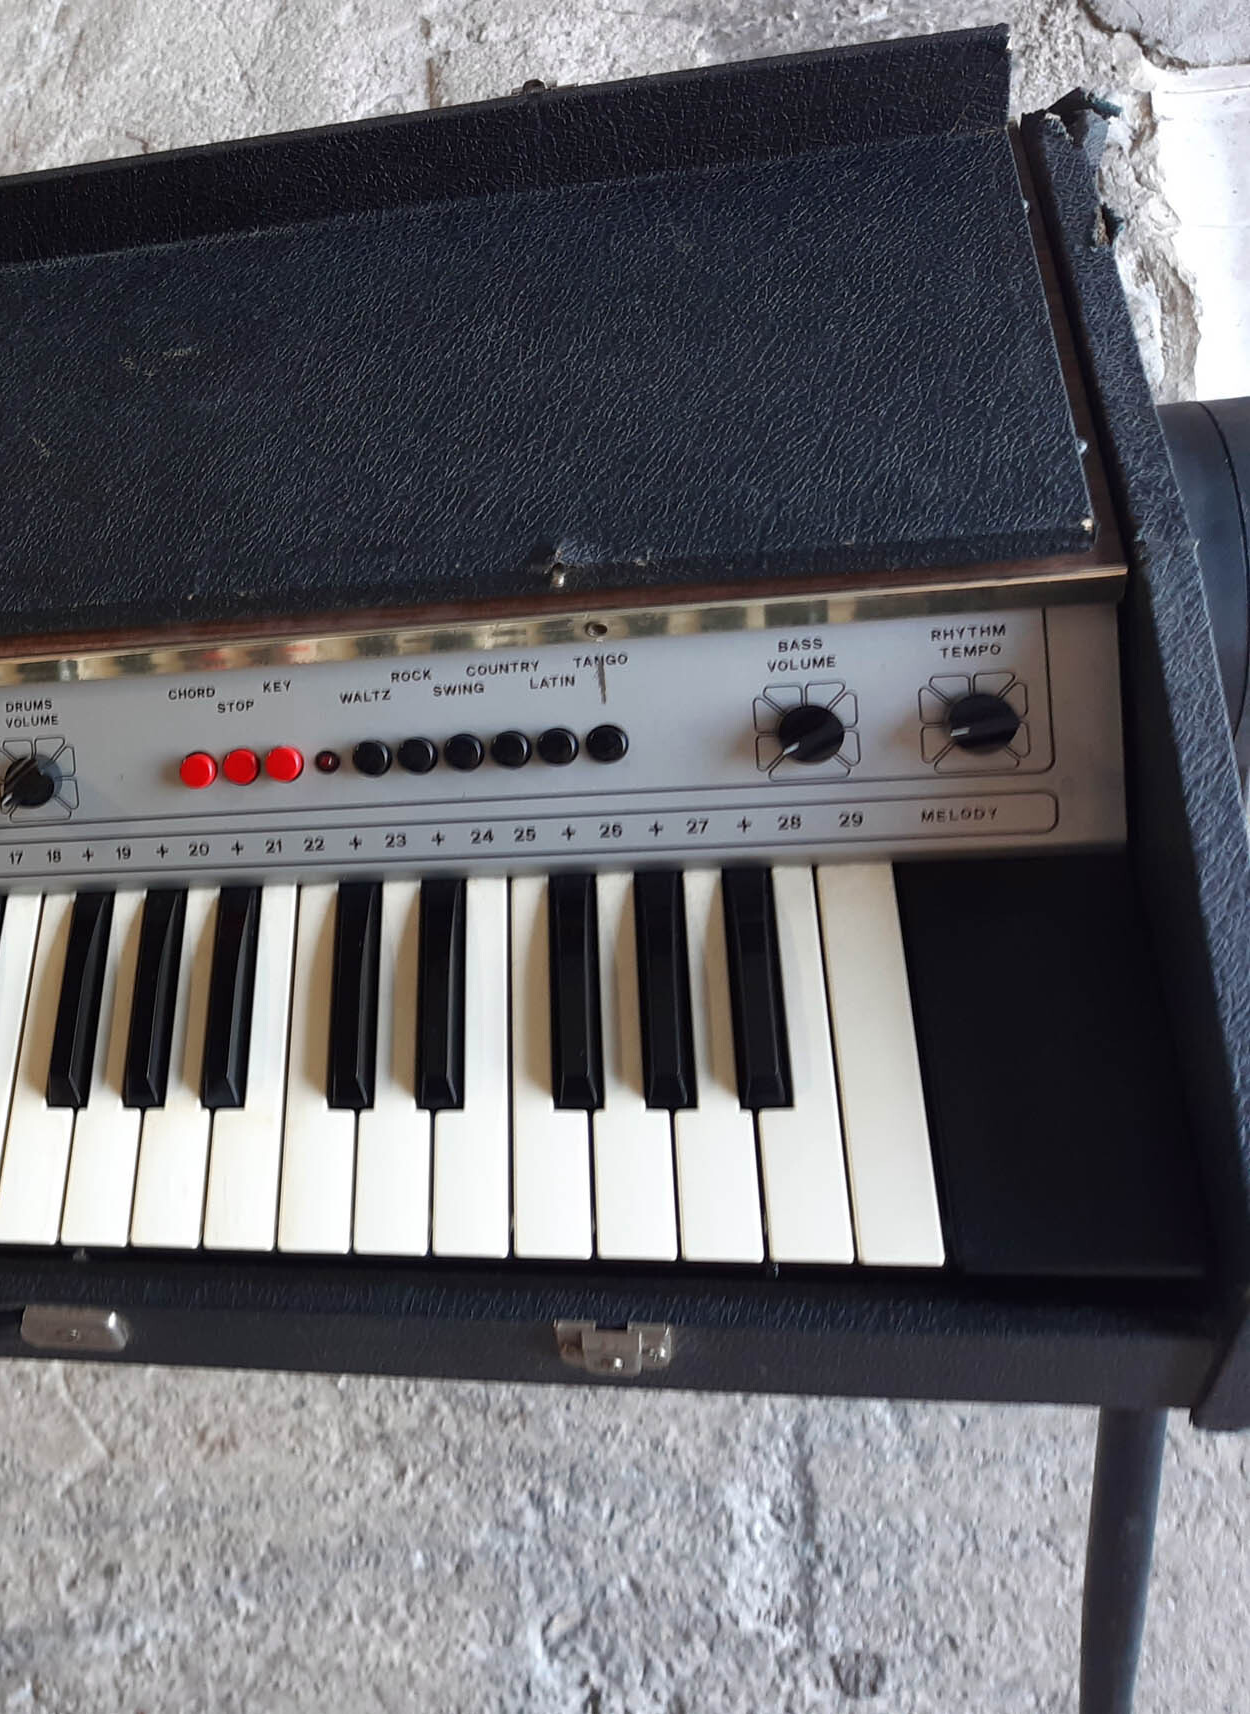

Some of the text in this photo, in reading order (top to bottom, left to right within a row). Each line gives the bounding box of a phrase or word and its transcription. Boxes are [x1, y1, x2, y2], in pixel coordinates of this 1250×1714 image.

[931, 624, 1005, 641] RHYTHM
[778, 638, 822, 652] BASS
[940, 643, 1001, 658] TEMPO
[466, 660, 539, 675] COUNTRY
[573, 652, 629, 669] TANGO
[767, 656, 835, 672] VOLUME
[391, 669, 431, 683] ROCK
[530, 675, 575, 689] LATIN
[263, 680, 290, 693] KEY
[433, 683, 484, 697] SWING
[168, 688, 215, 700] CHORD
[340, 689, 390, 705] WALTZ
[6, 700, 52, 712] DRUMS
[218, 700, 254, 713] STOP
[6, 715, 58, 728] VOLUME
[10, 852, 23, 864] 17
[47, 850, 61, 863] 18
[116, 847, 131, 860] 19
[189, 843, 209, 856] 20
[266, 839, 281, 853] 21
[304, 838, 324, 851] 22
[385, 834, 406, 848] 23
[471, 829, 493, 844] 24
[514, 826, 536, 842] 25
[600, 824, 622, 838] 26
[686, 819, 708, 834] 27
[778, 815, 801, 830] 28
[839, 813, 863, 827] 29
[921, 808, 997, 822] MELODY
